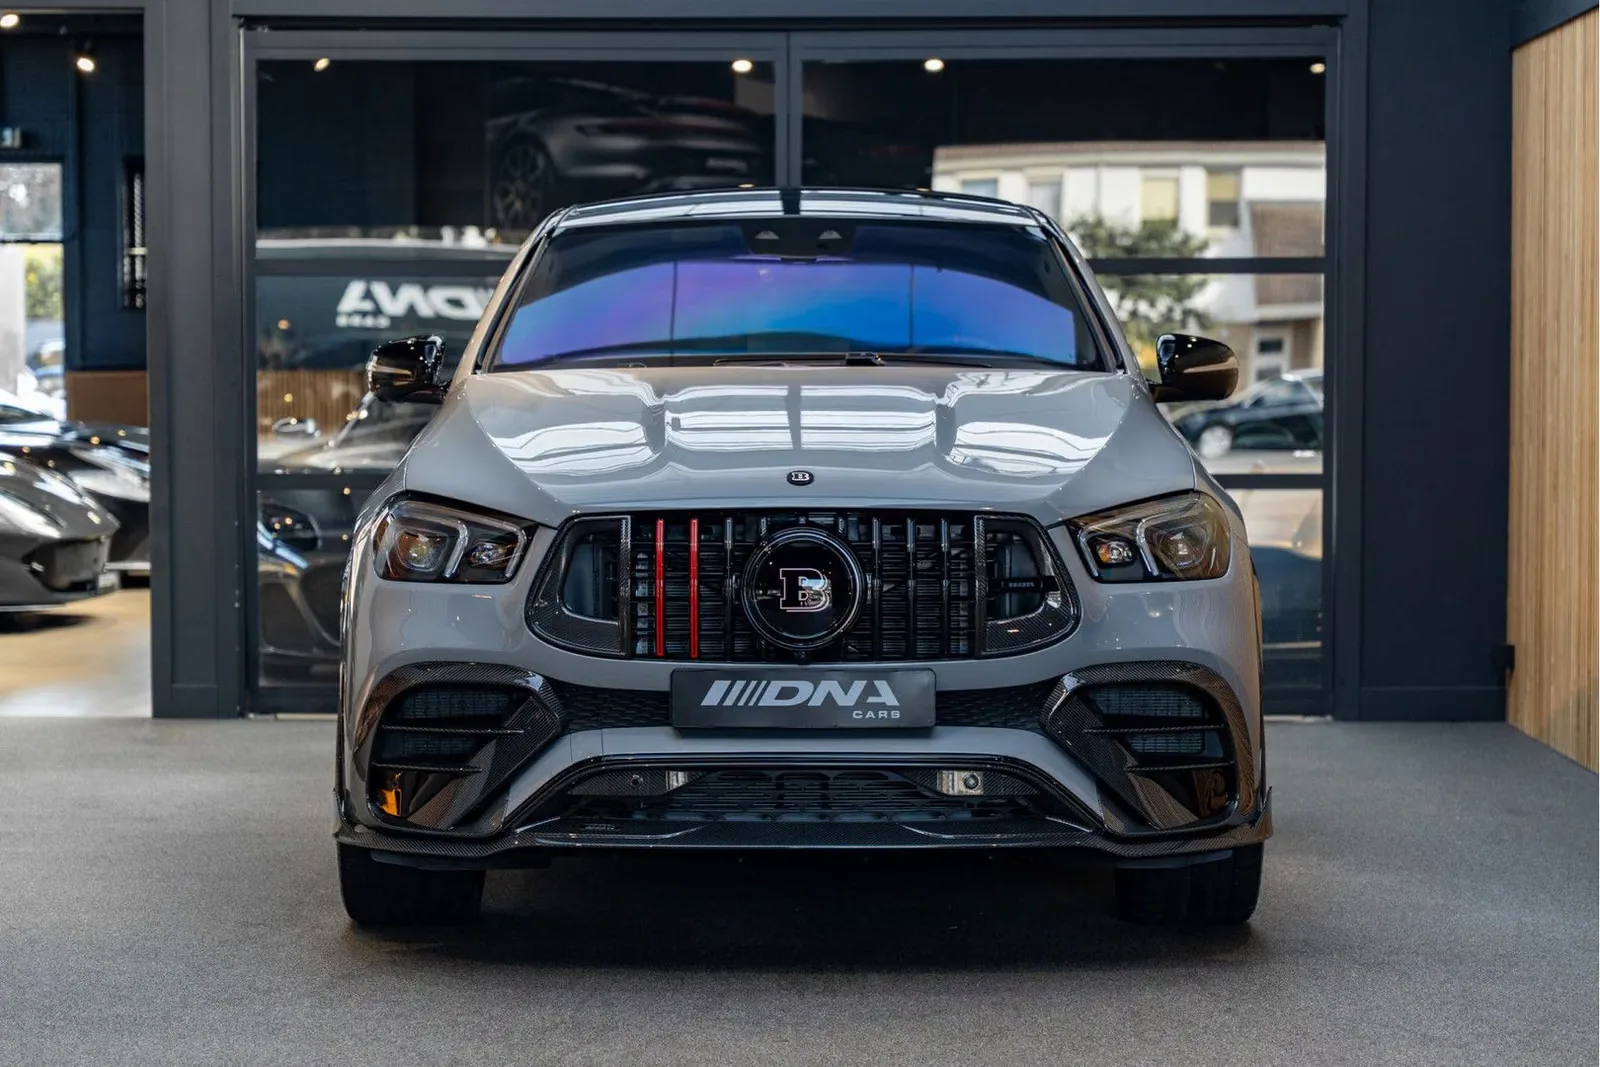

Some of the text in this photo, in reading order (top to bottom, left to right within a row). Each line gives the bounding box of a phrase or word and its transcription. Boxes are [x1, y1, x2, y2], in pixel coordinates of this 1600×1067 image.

[779, 567, 830, 613] B
[756, 680, 901, 706] DNA
[852, 710, 901, 719] CARS
